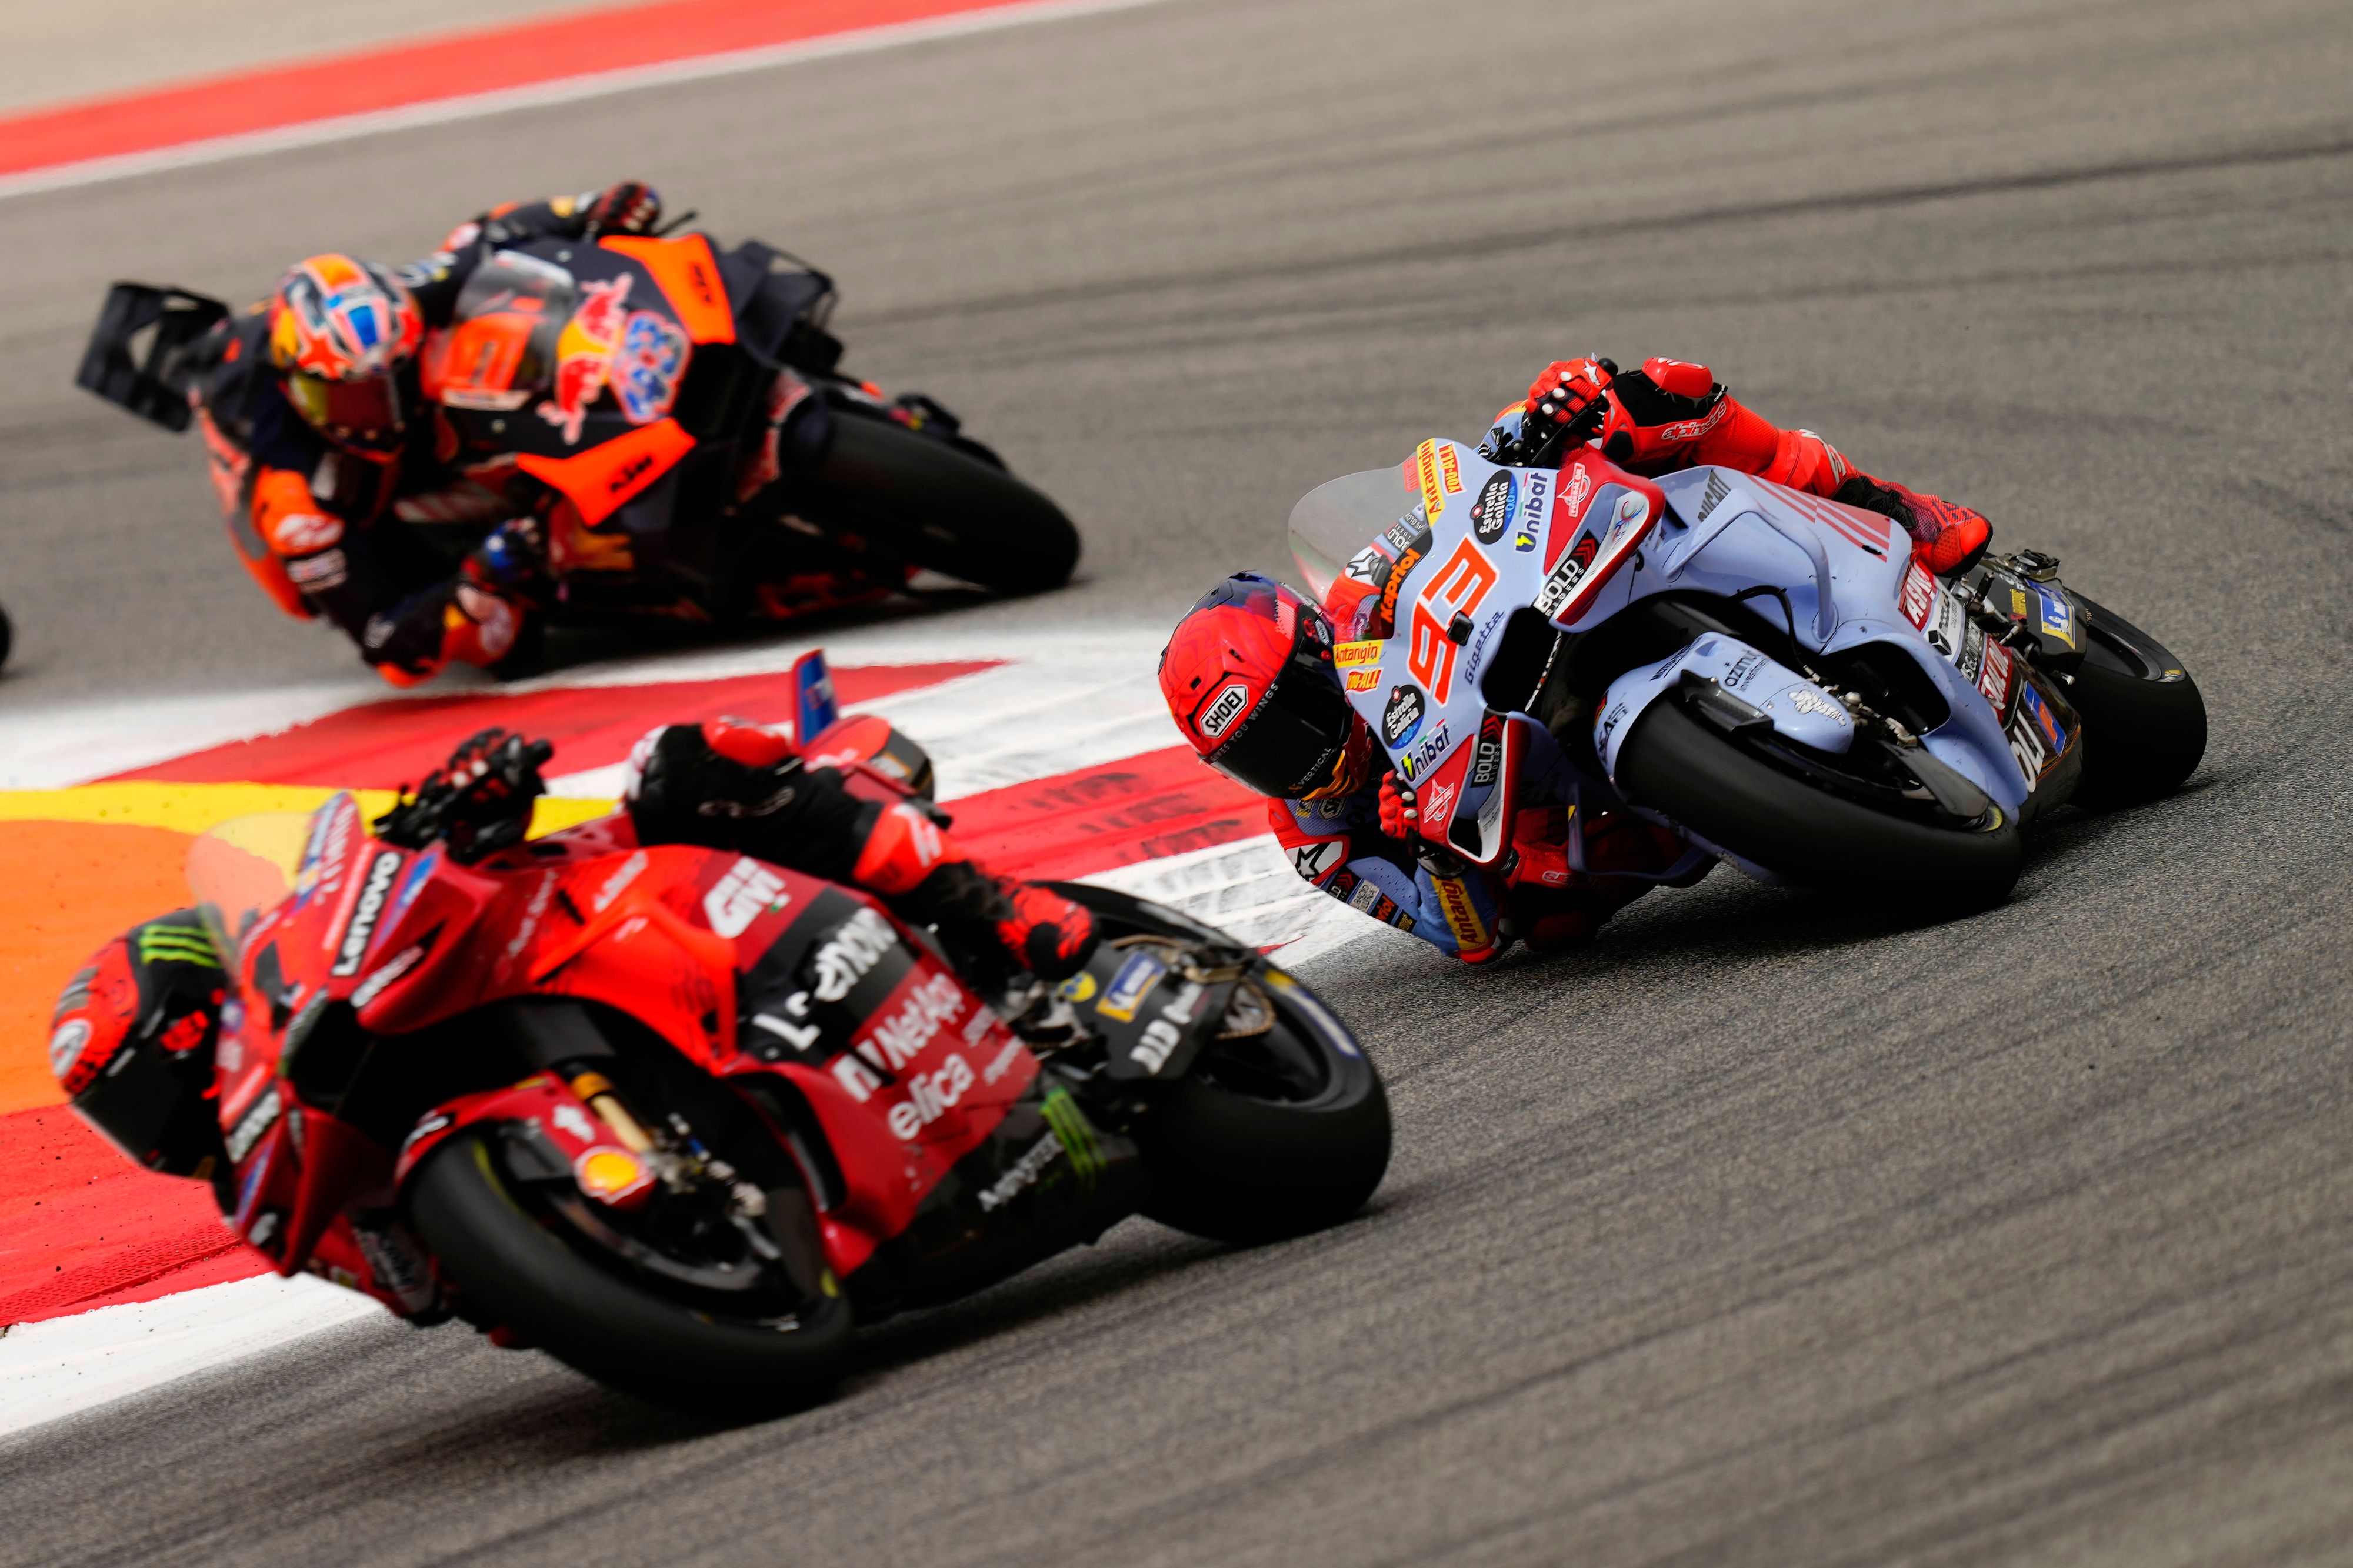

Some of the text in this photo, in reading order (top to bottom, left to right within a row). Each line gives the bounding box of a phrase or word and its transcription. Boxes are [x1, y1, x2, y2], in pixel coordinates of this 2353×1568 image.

[1421, 442, 1442, 514] Antangin
[1439, 444, 1462, 493] YOU-ALL
[1479, 481, 1498, 534] Estrella
[1491, 481, 1509, 530] Galicia
[1516, 472, 1548, 552] Unibat
[1380, 547, 1421, 623] Kapriol
[1532, 559, 1580, 614] BOLD
[1545, 568, 1585, 617] RIDERS
[1407, 535, 1500, 708] 93
[1464, 610, 1505, 686] Gigetta
[1335, 643, 1379, 664] Antangin
[1205, 692, 1243, 733] SHOEI
[1230, 724, 1249, 743] YOU
[1248, 683, 1279, 722] WINGS
[1386, 692, 1417, 728] Estrella
[1390, 706, 1420, 739] Galicia
[1297, 746, 1332, 787] VERTICAL
[1401, 724, 1451, 782] Unibat
[1474, 742, 1495, 783] BOLD
[332, 850, 401, 976] Lenovo
[703, 856, 786, 939] GIVI
[875, 973, 964, 1070] NetApp
[889, 1053, 975, 1140] elica
